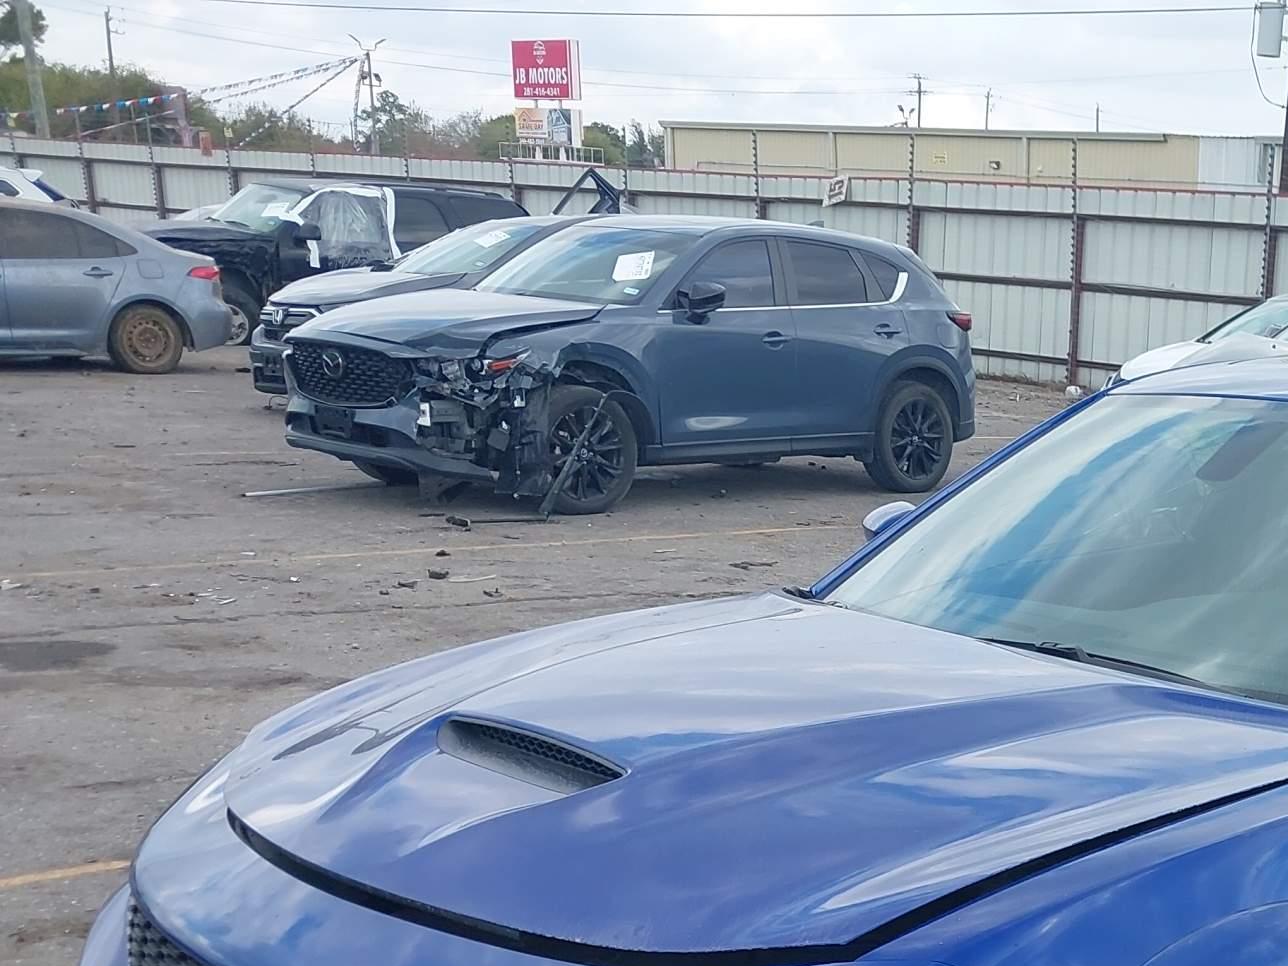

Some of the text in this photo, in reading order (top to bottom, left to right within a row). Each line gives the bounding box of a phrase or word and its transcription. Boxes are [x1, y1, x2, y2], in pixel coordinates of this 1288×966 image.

[515, 66, 568, 85] JB MOTORS
[523, 87, 561, 96] 281-416-4341
